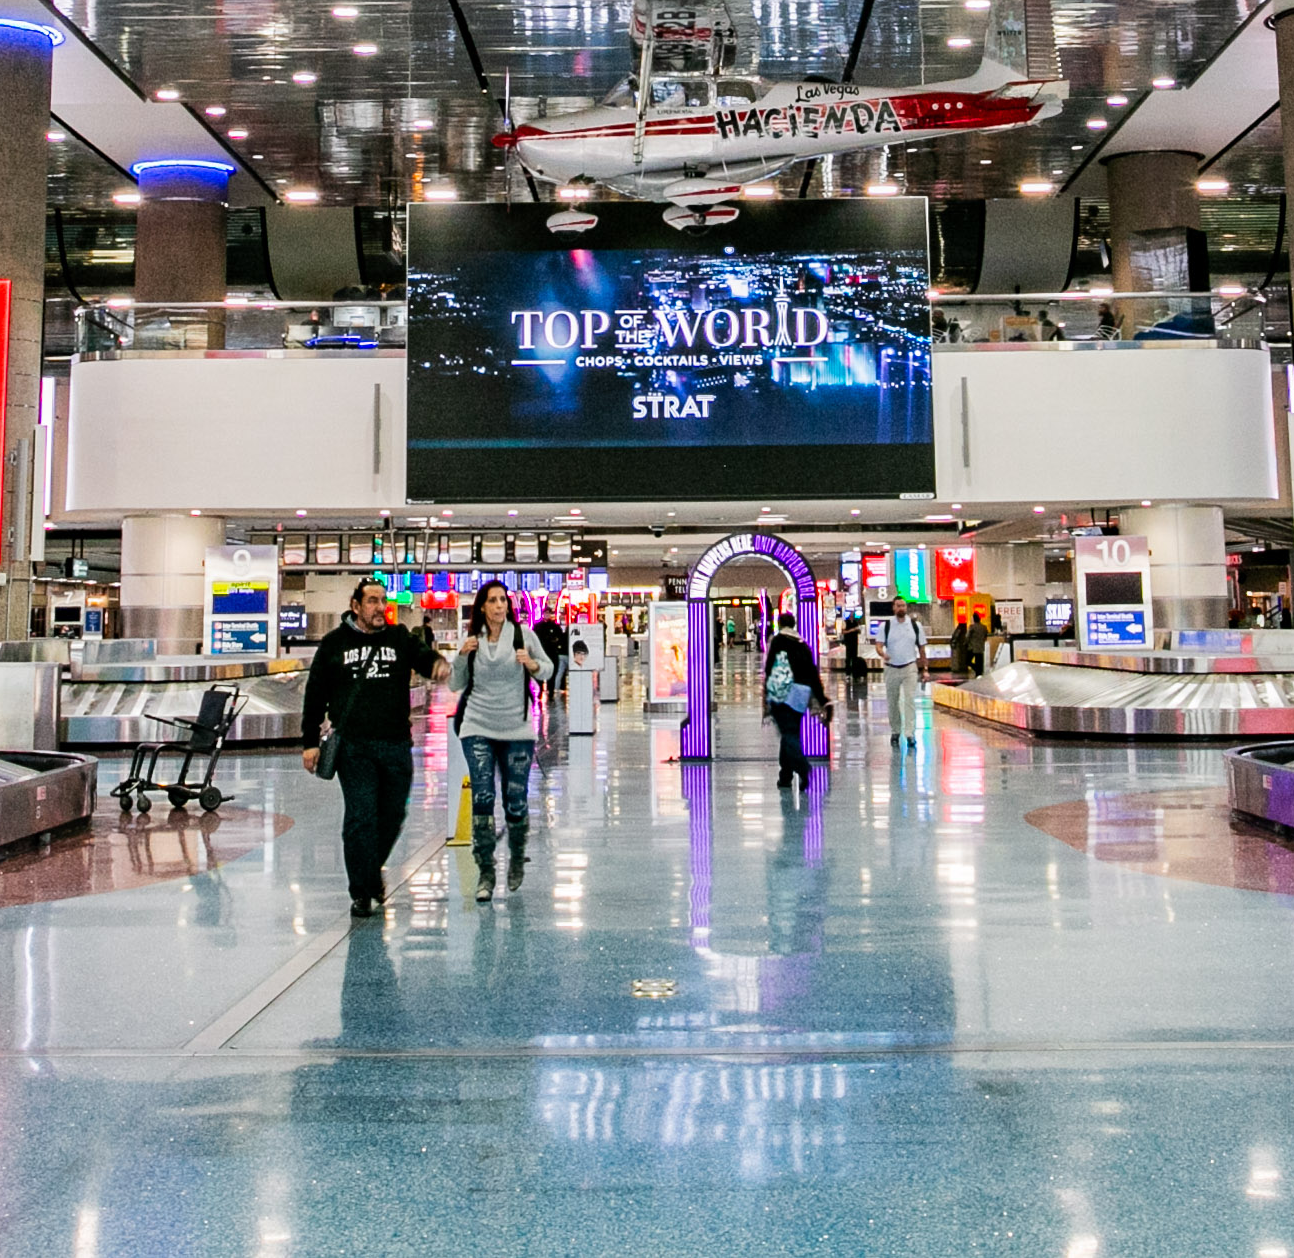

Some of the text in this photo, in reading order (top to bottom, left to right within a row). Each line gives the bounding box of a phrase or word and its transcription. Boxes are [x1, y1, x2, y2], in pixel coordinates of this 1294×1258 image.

[795, 82, 860, 102] Las Vegas
[511, 310, 611, 349] TOP
[619, 314, 642, 329] OF
[615, 329, 647, 344] THE
[575, 354, 763, 367] CHOPS COCKTAILS VIEWS
[632, 395, 716, 419] STRAT
[1096, 540, 1131, 566] 10
[233, 549, 251, 576] 9
[697, 540, 734, 578] HAPPENS
[754, 534, 777, 554] ONLY
[774, 542, 809, 578] HAPPENS
[796, 575, 816, 600] HERE
[64, 592, 73, 603] 7
[878, 587, 888, 599] 8
[997, 607, 1021, 615] FREE
[343, 648, 359, 665] LOS
